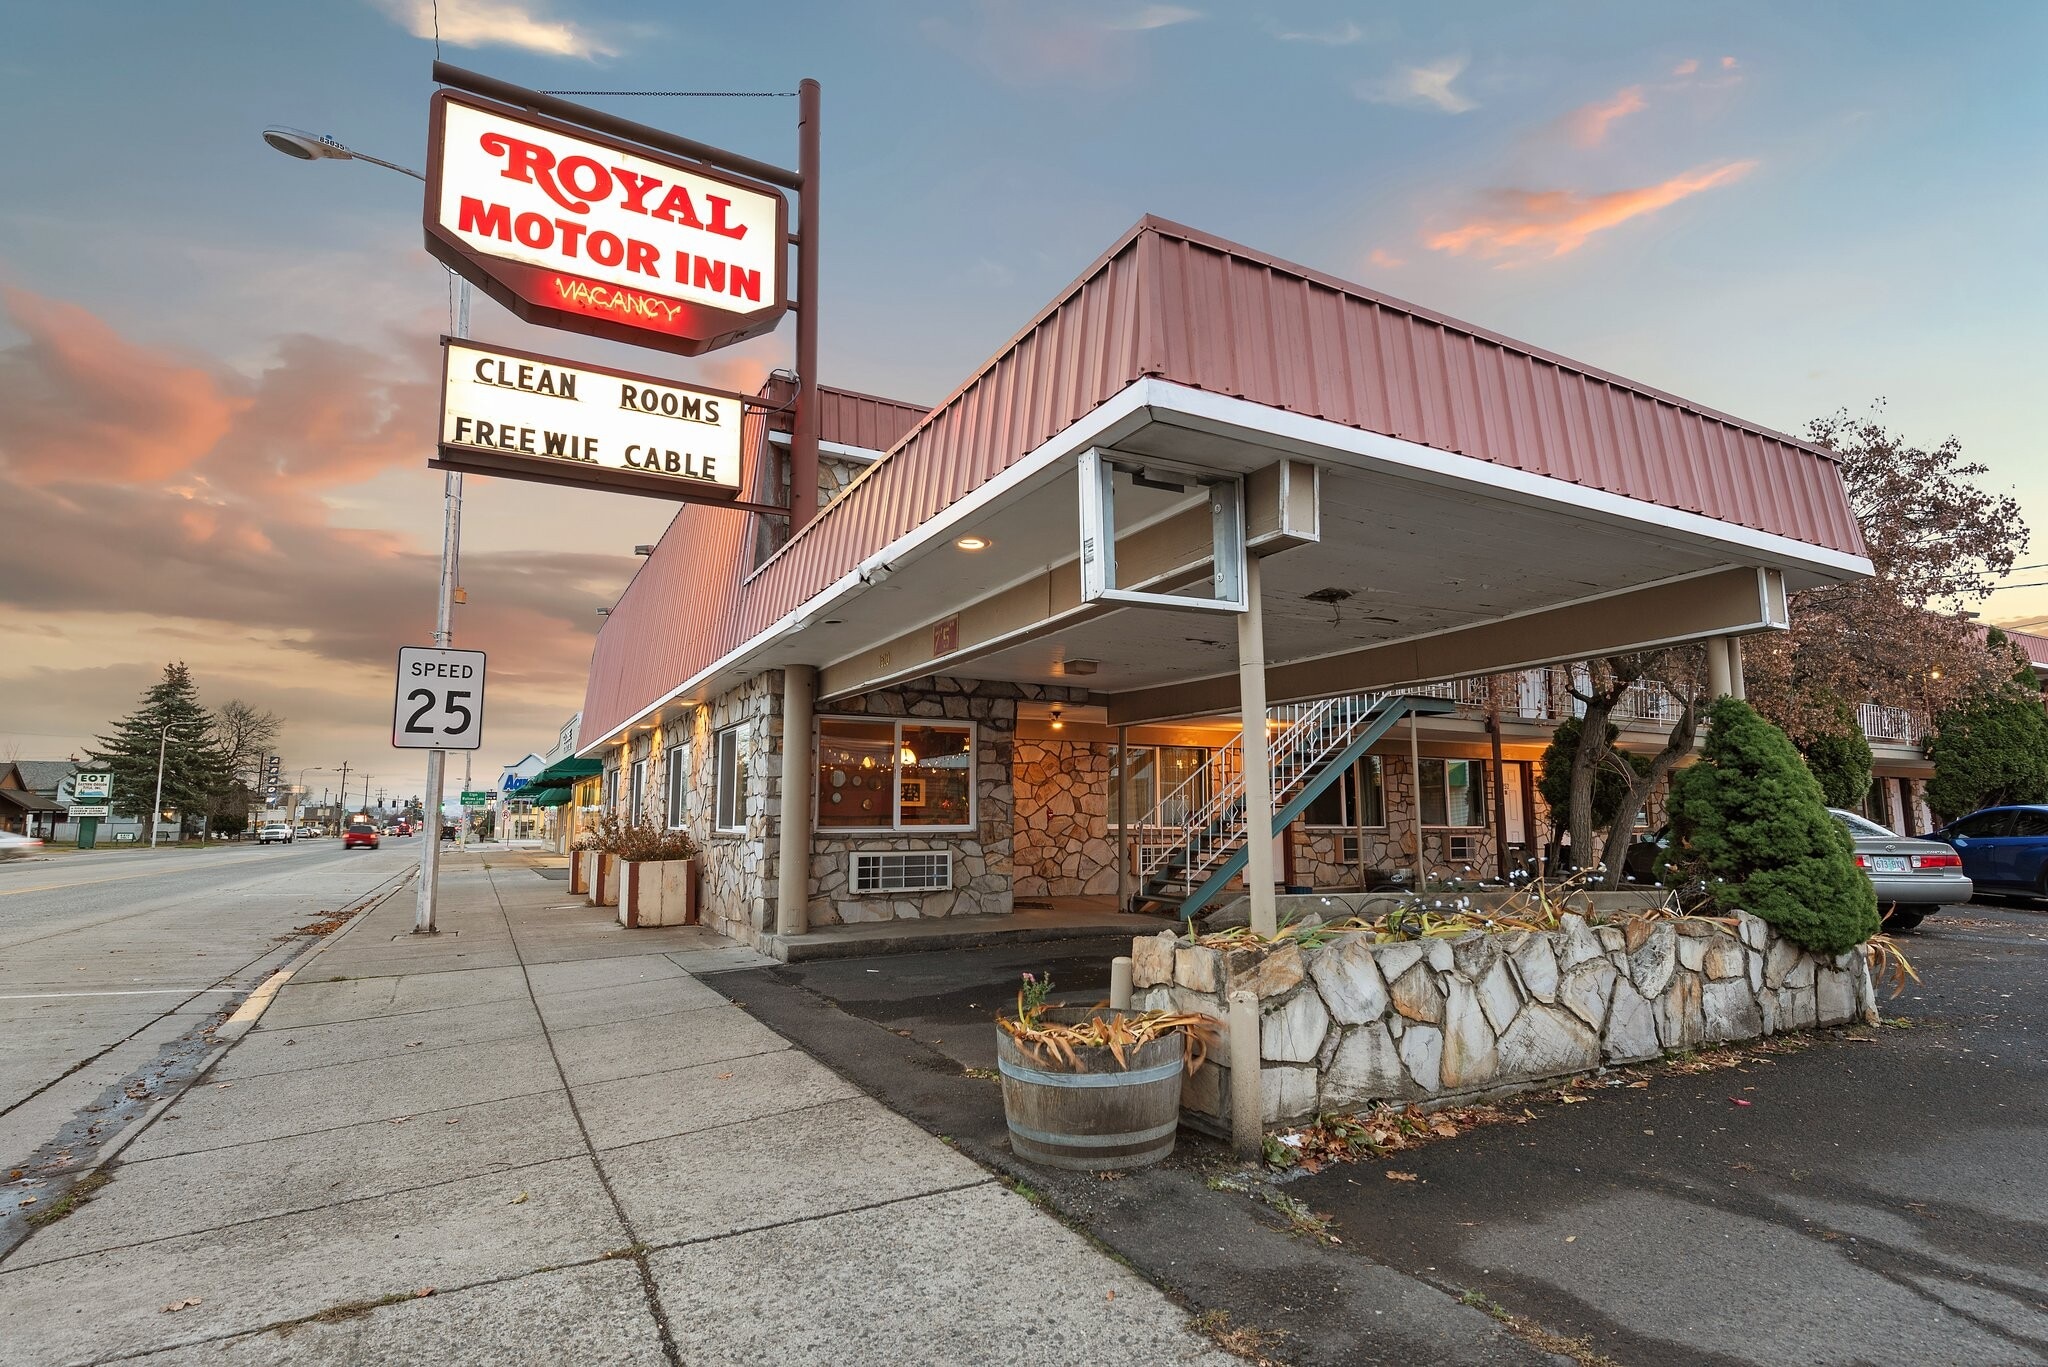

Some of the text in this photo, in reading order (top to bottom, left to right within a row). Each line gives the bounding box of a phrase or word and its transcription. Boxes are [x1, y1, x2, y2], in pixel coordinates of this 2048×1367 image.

[480, 132, 748, 240] ROYAL
[458, 195, 760, 302] MOTOR INN
[555, 278, 681, 321] VACANCY
[475, 358, 719, 422] CLEAN ROOMS
[625, 444, 716, 480] CABLE
[411, 662, 473, 679] SPEED
[404, 688, 472, 735] 25
